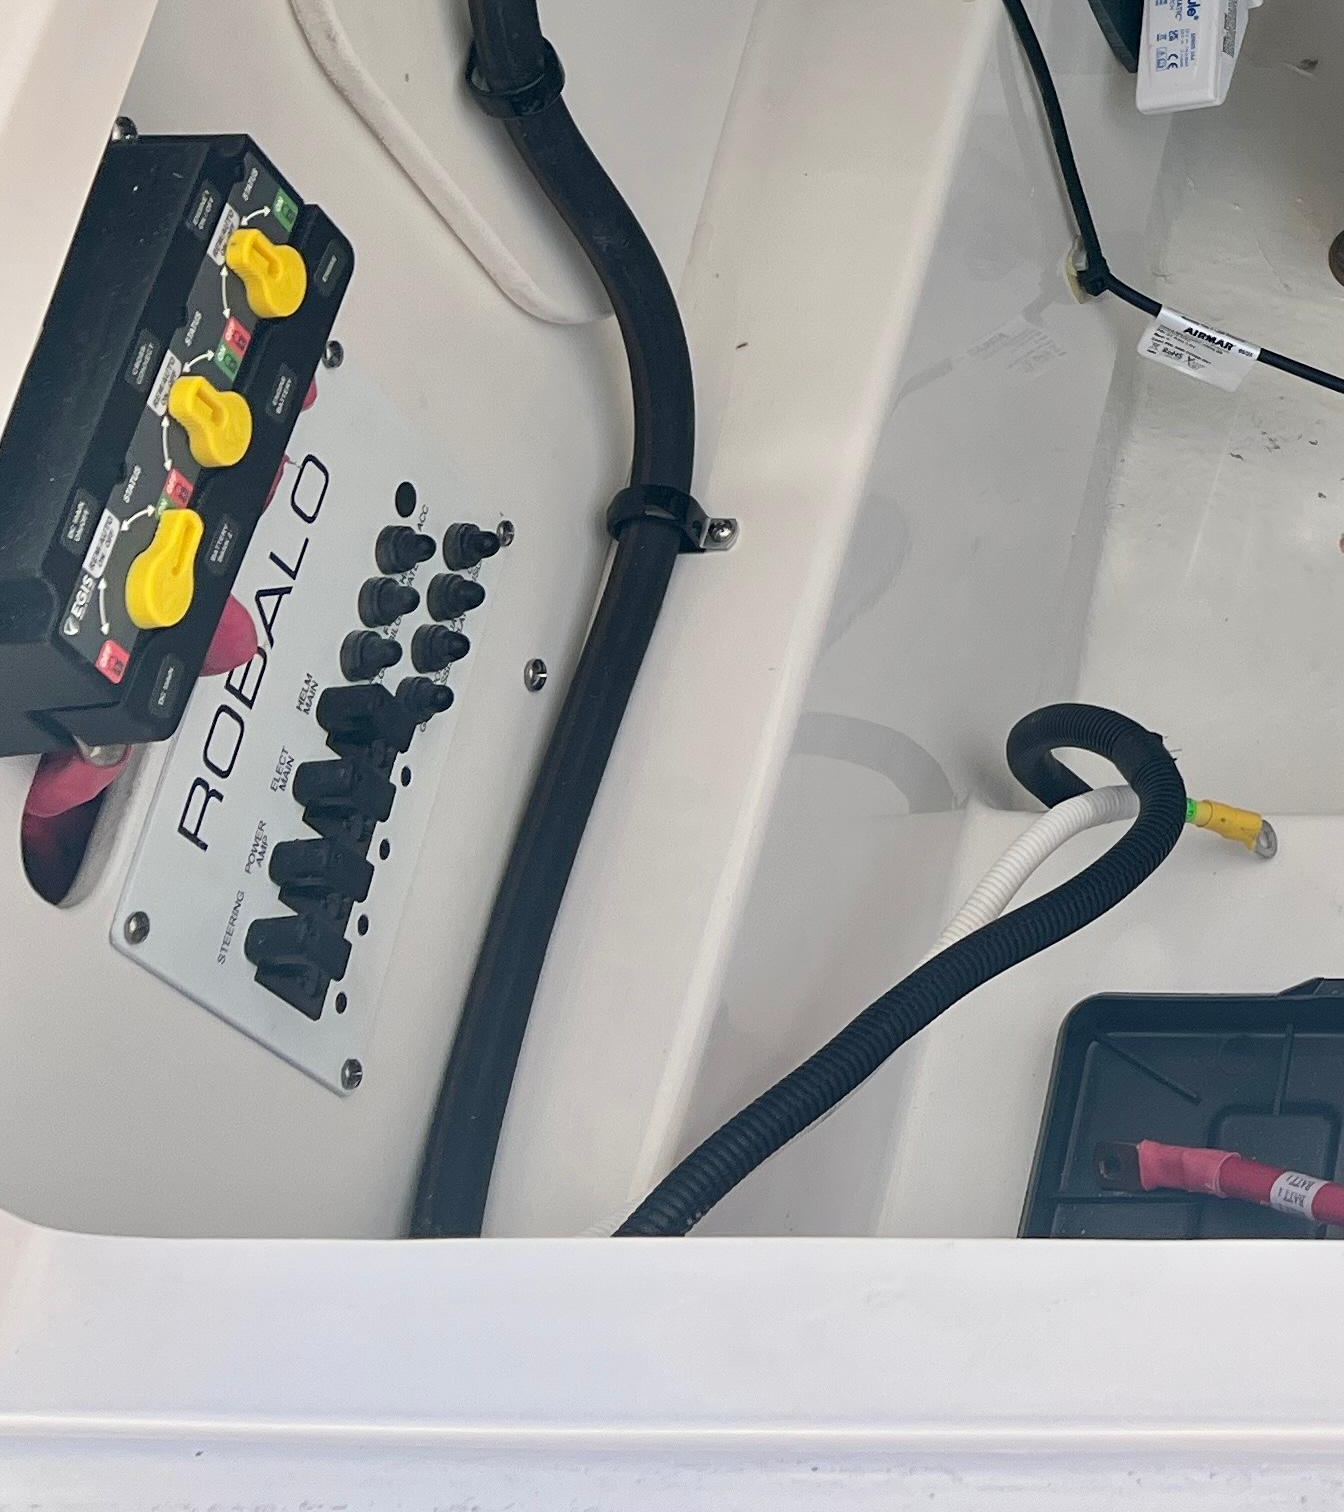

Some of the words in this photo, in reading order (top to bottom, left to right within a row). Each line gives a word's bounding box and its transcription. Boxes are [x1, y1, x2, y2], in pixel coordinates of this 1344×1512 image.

[185, 311, 202, 346] STATUS
[1183, 327, 1234, 351] AIRMAR
[1162, 347, 1184, 360] RoHS
[123, 464, 142, 504] STATUS
[417, 504, 429, 531] ACC
[71, 577, 95, 619] EGIS
[177, 454, 330, 852] ROBALO
[295, 672, 313, 712] HELM
[303, 678, 319, 715] MAIN
[270, 745, 288, 792] ELECT
[279, 755, 295, 792] MAIN
[245, 820, 267, 874] POWER
[257, 834, 269, 868] AMP
[217, 890, 244, 965] STEERING
